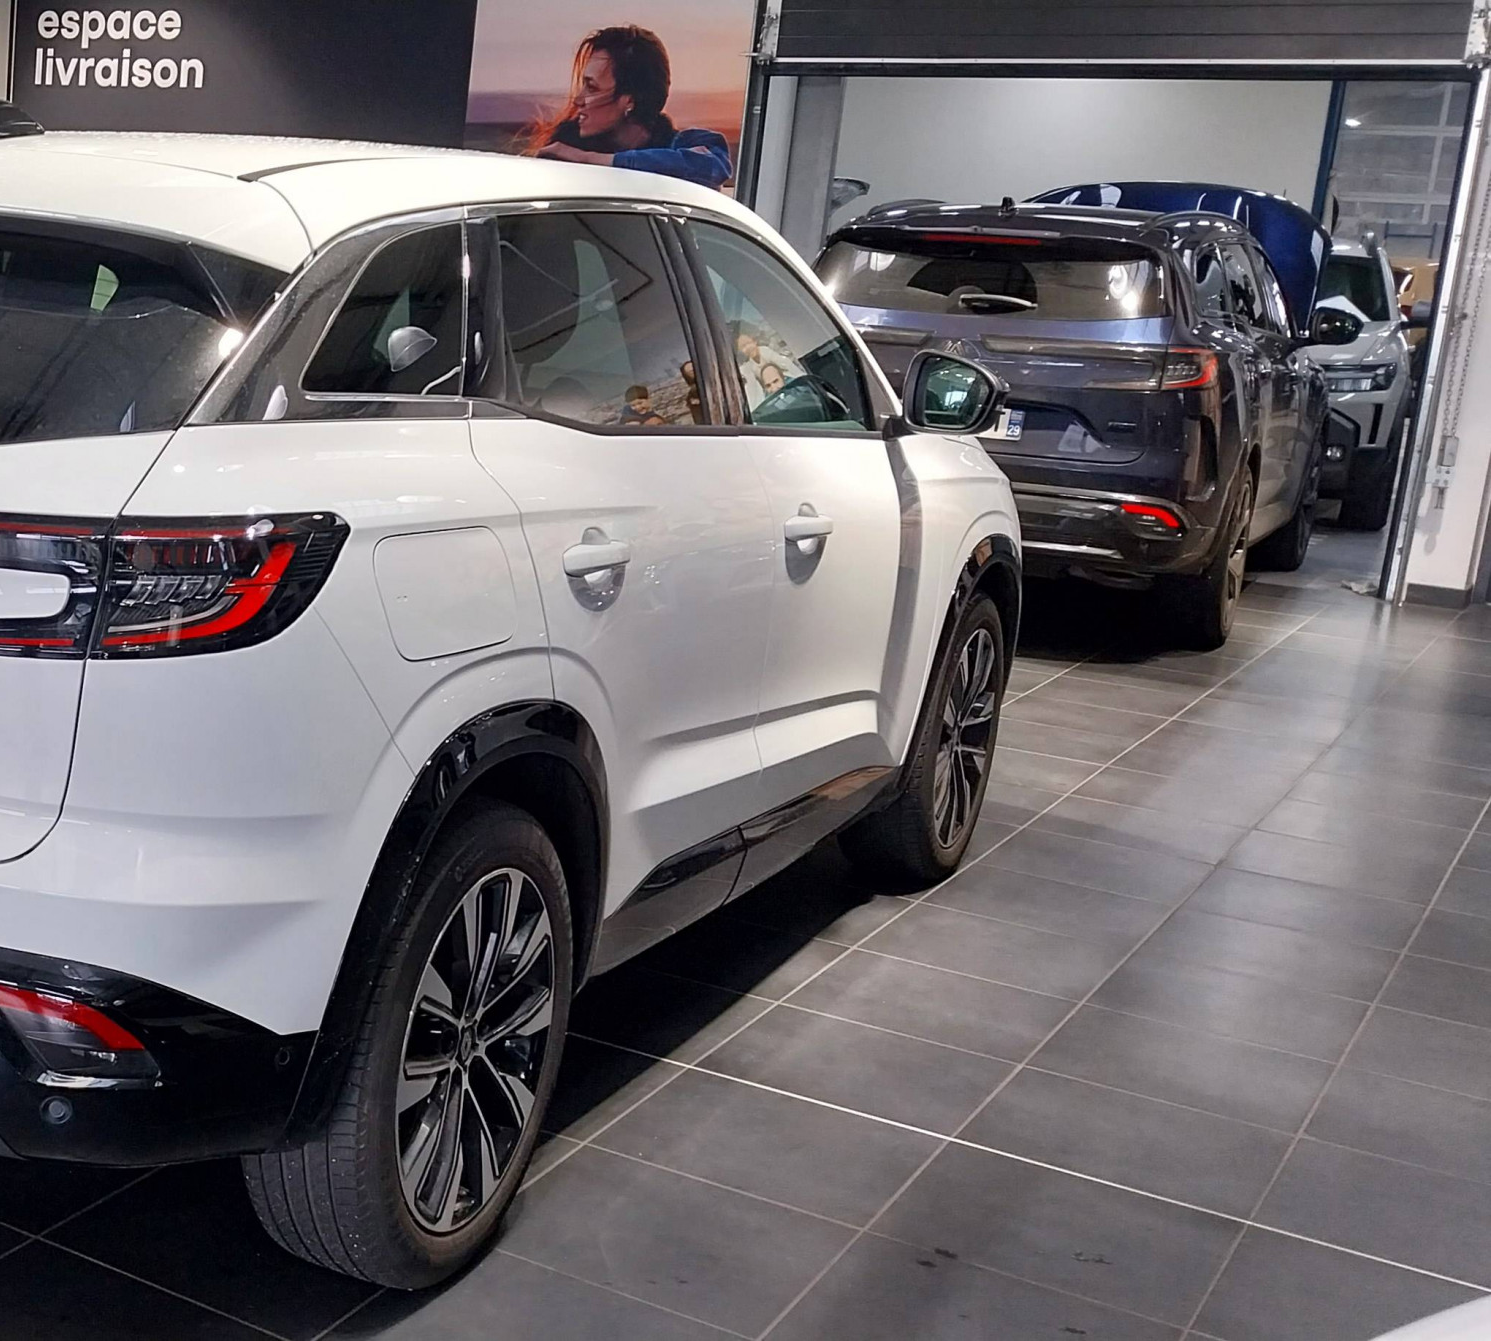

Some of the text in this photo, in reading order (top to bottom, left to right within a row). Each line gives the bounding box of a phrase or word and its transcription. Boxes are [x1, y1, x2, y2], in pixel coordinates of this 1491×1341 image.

[37, 9, 182, 49] espace
[34, 47, 205, 89] livraison
[1006, 424, 1021, 437] 29
